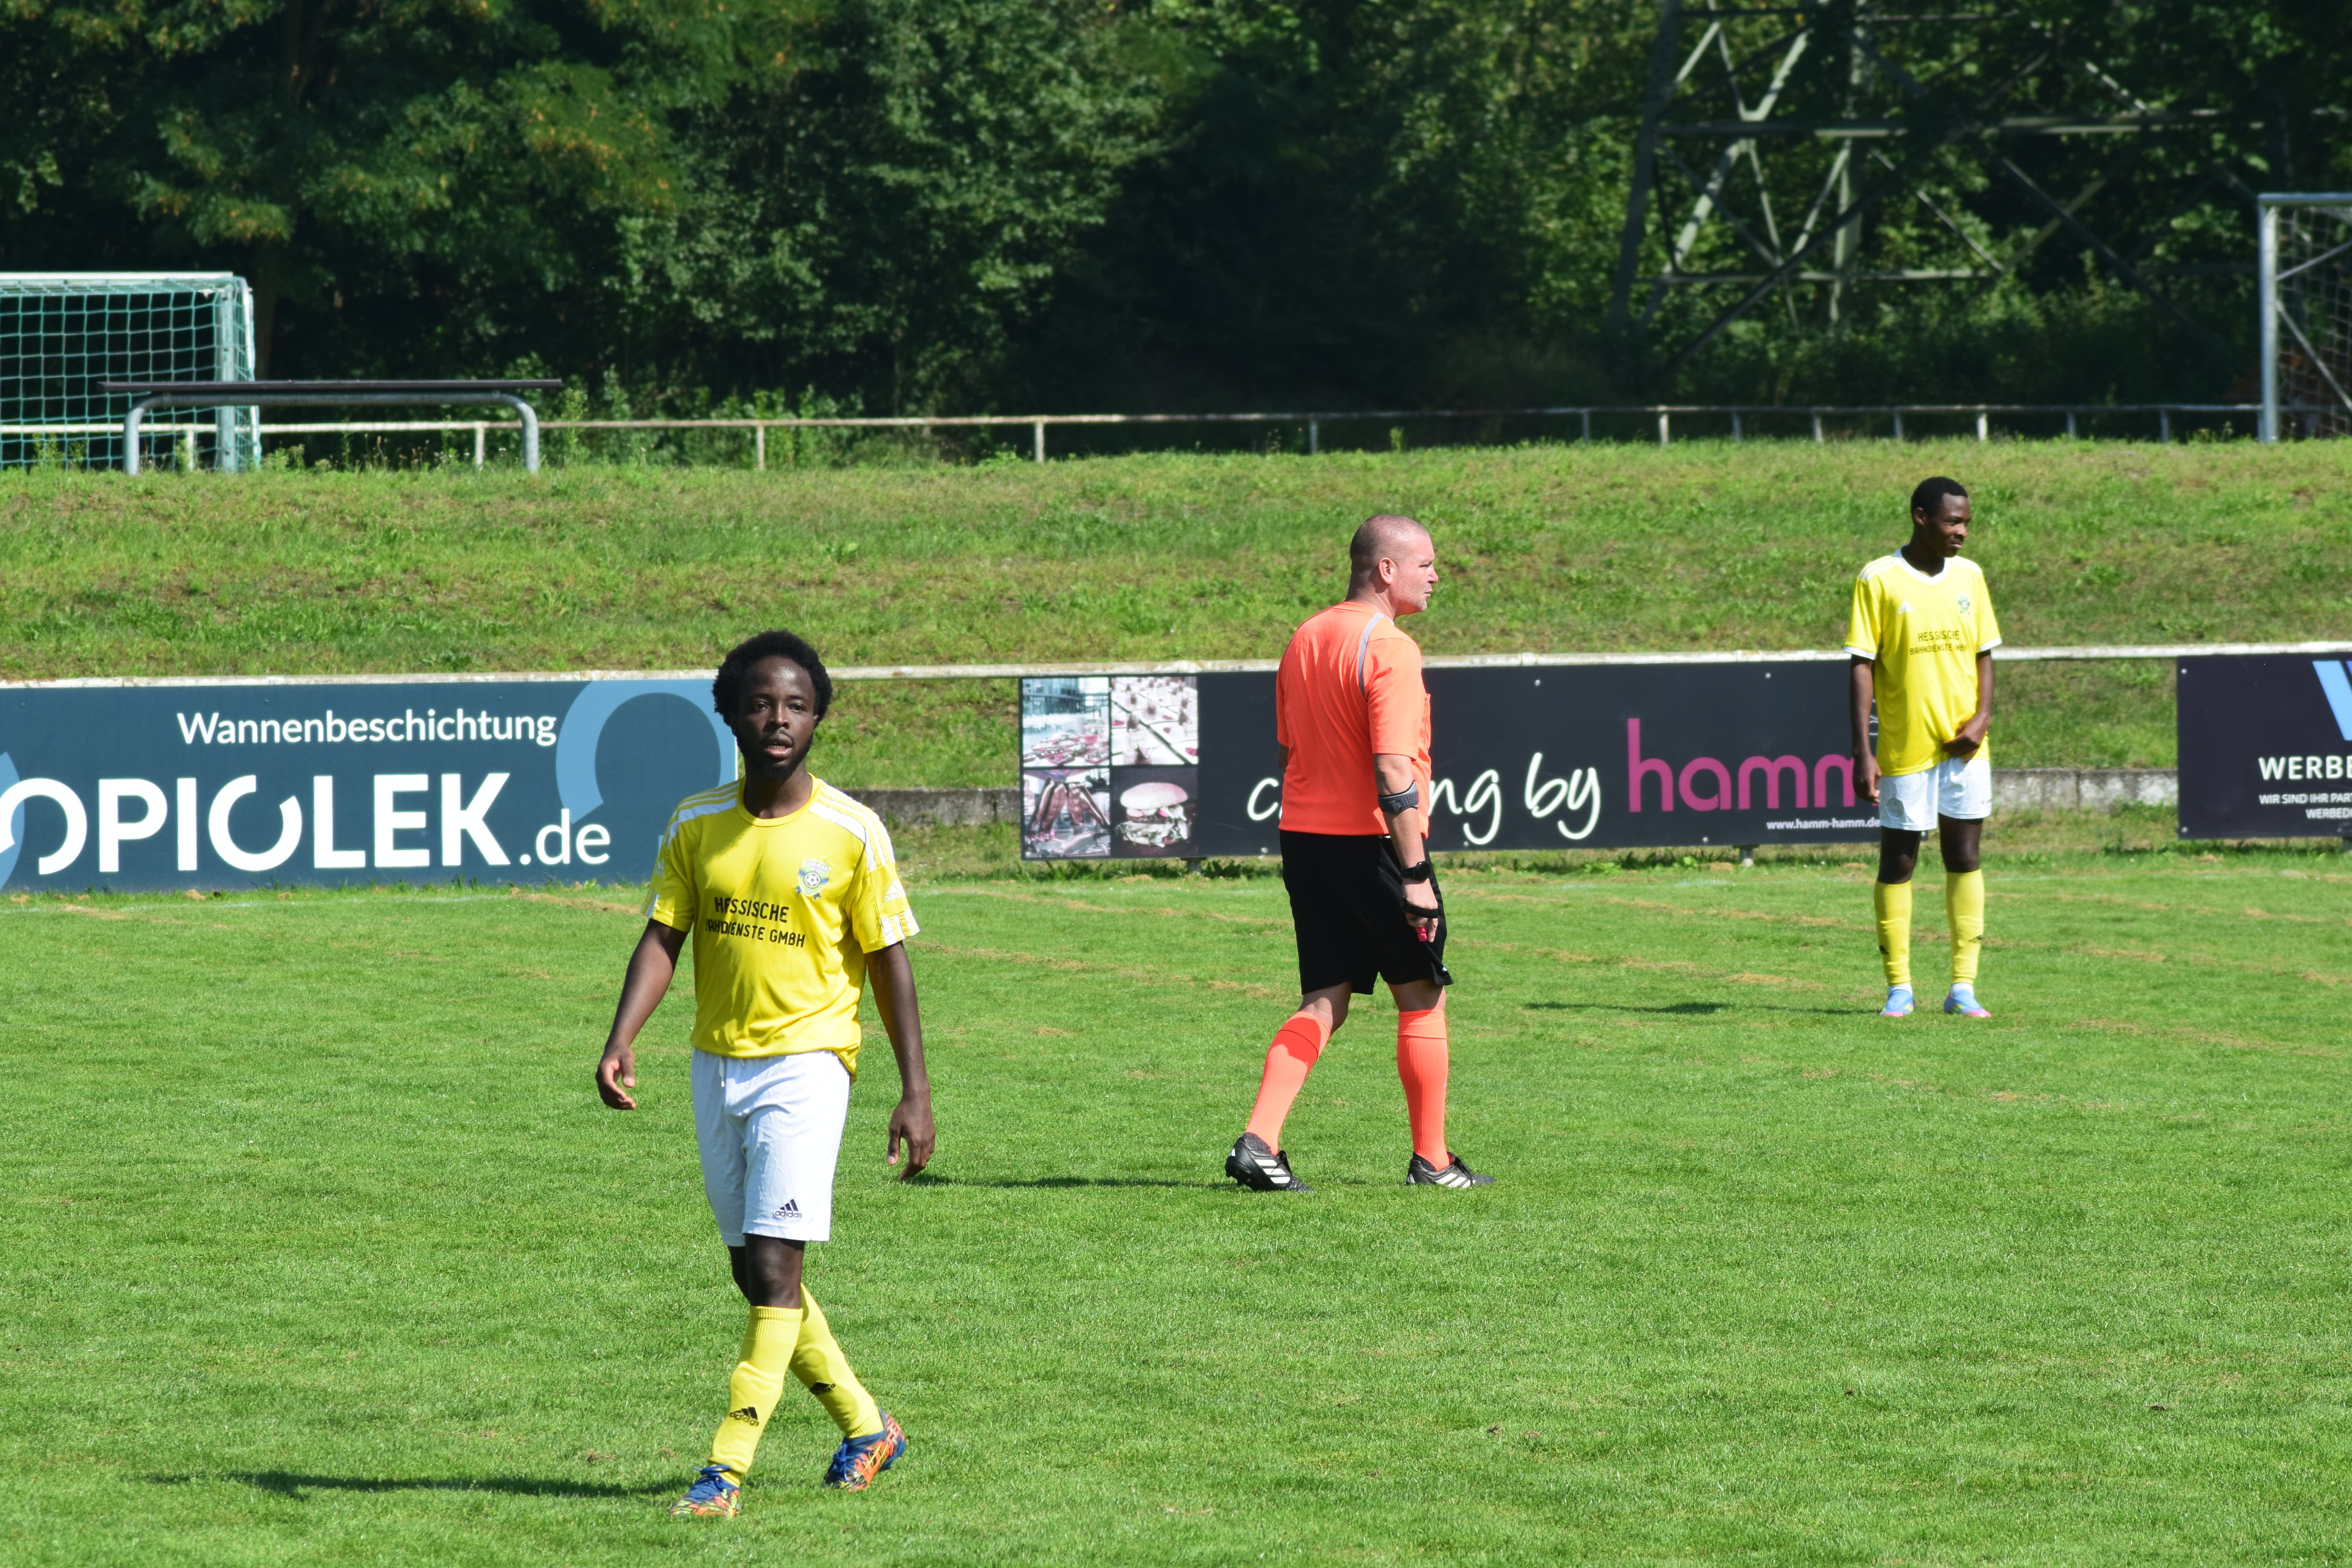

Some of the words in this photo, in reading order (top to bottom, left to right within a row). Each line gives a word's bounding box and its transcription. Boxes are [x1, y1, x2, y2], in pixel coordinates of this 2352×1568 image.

[176, 708, 557, 746] Wannenbeschichtung
[1525, 752, 1601, 840] by
[2259, 794, 2280, 804] WIR
[2281, 793, 2308, 804] SIND
[2310, 793, 2328, 803] IHR
[1766, 817, 1880, 830] www.hamm-hamm.de
[769, 929, 806, 948] GMBH
[775, 1210, 802, 1218] adidas
